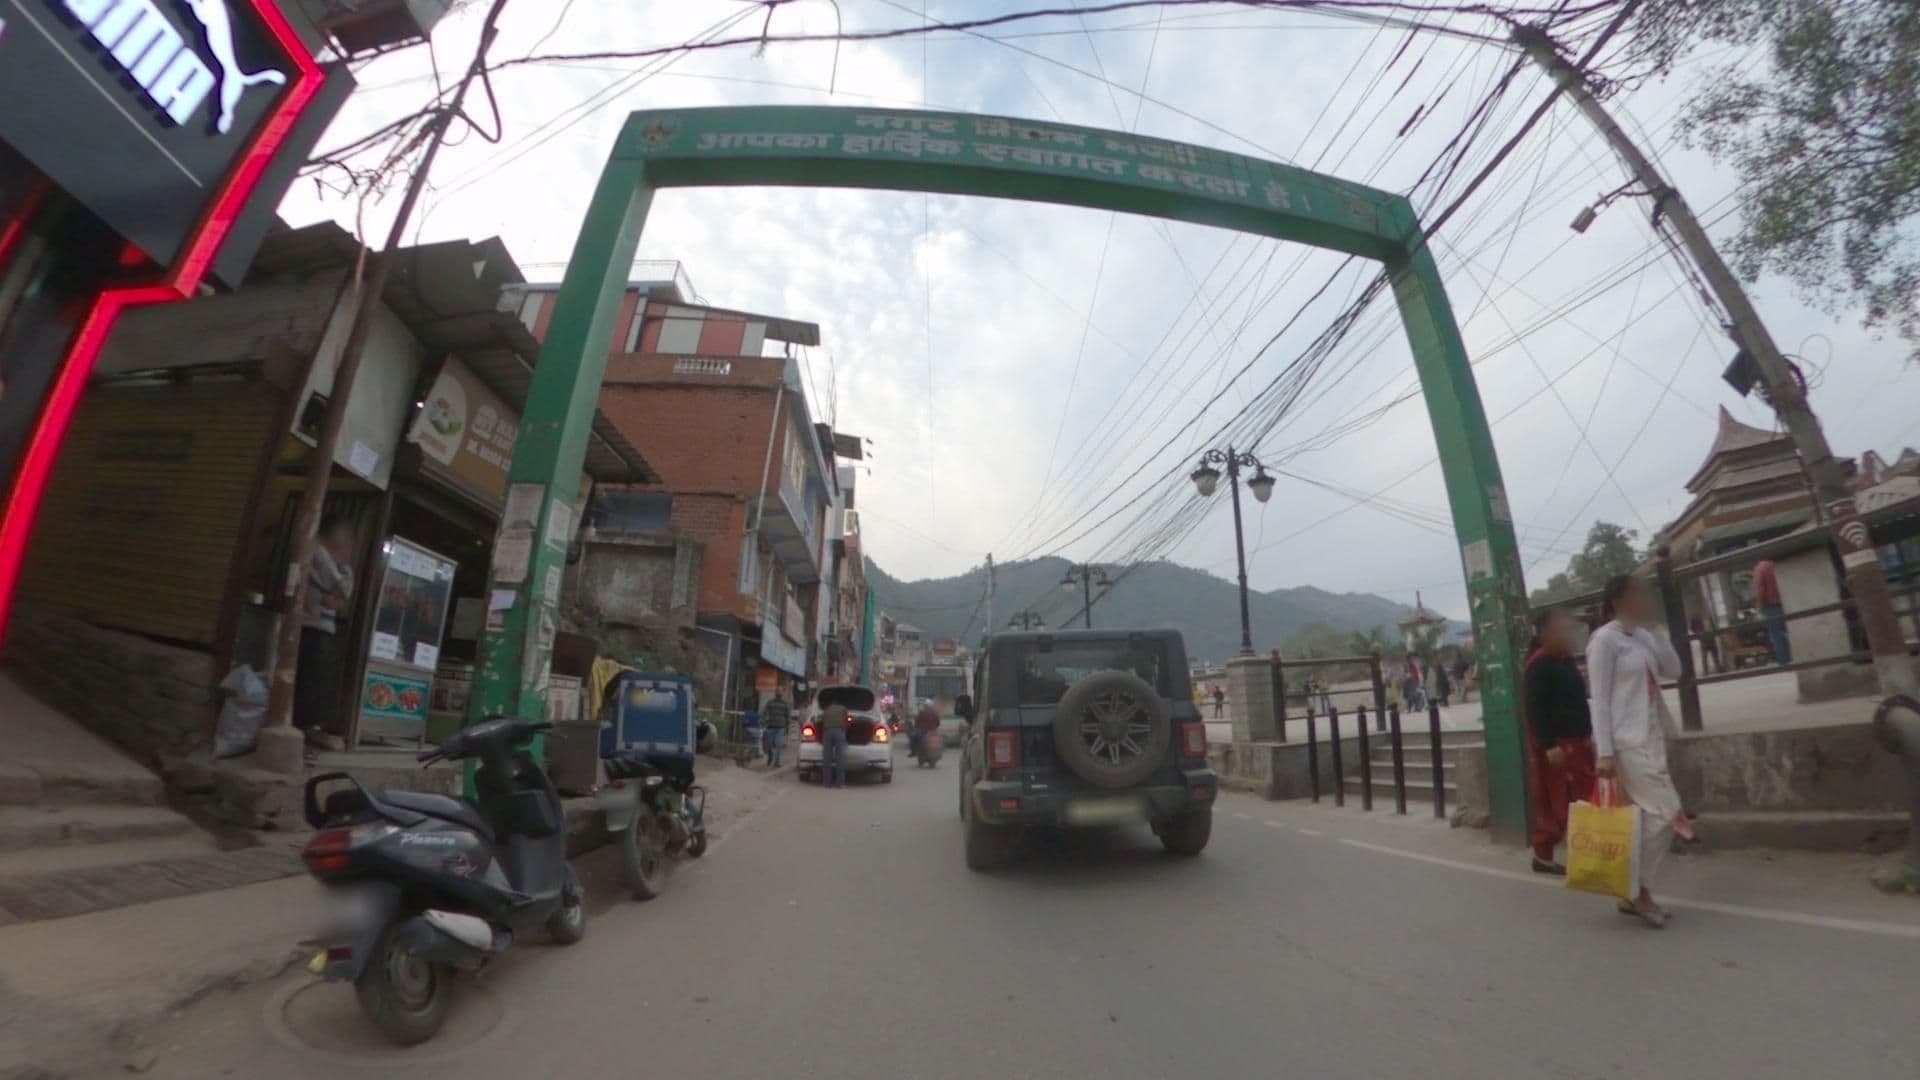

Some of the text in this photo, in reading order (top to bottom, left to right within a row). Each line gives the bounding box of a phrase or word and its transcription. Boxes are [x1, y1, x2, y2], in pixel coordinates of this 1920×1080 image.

[855, 113, 958, 134] नगर
[696, 132, 832, 151] आपका
[842, 130, 962, 157] हार्दिक
[974, 143, 1128, 176] स्वागत
[1138, 163, 1252, 198] करता
